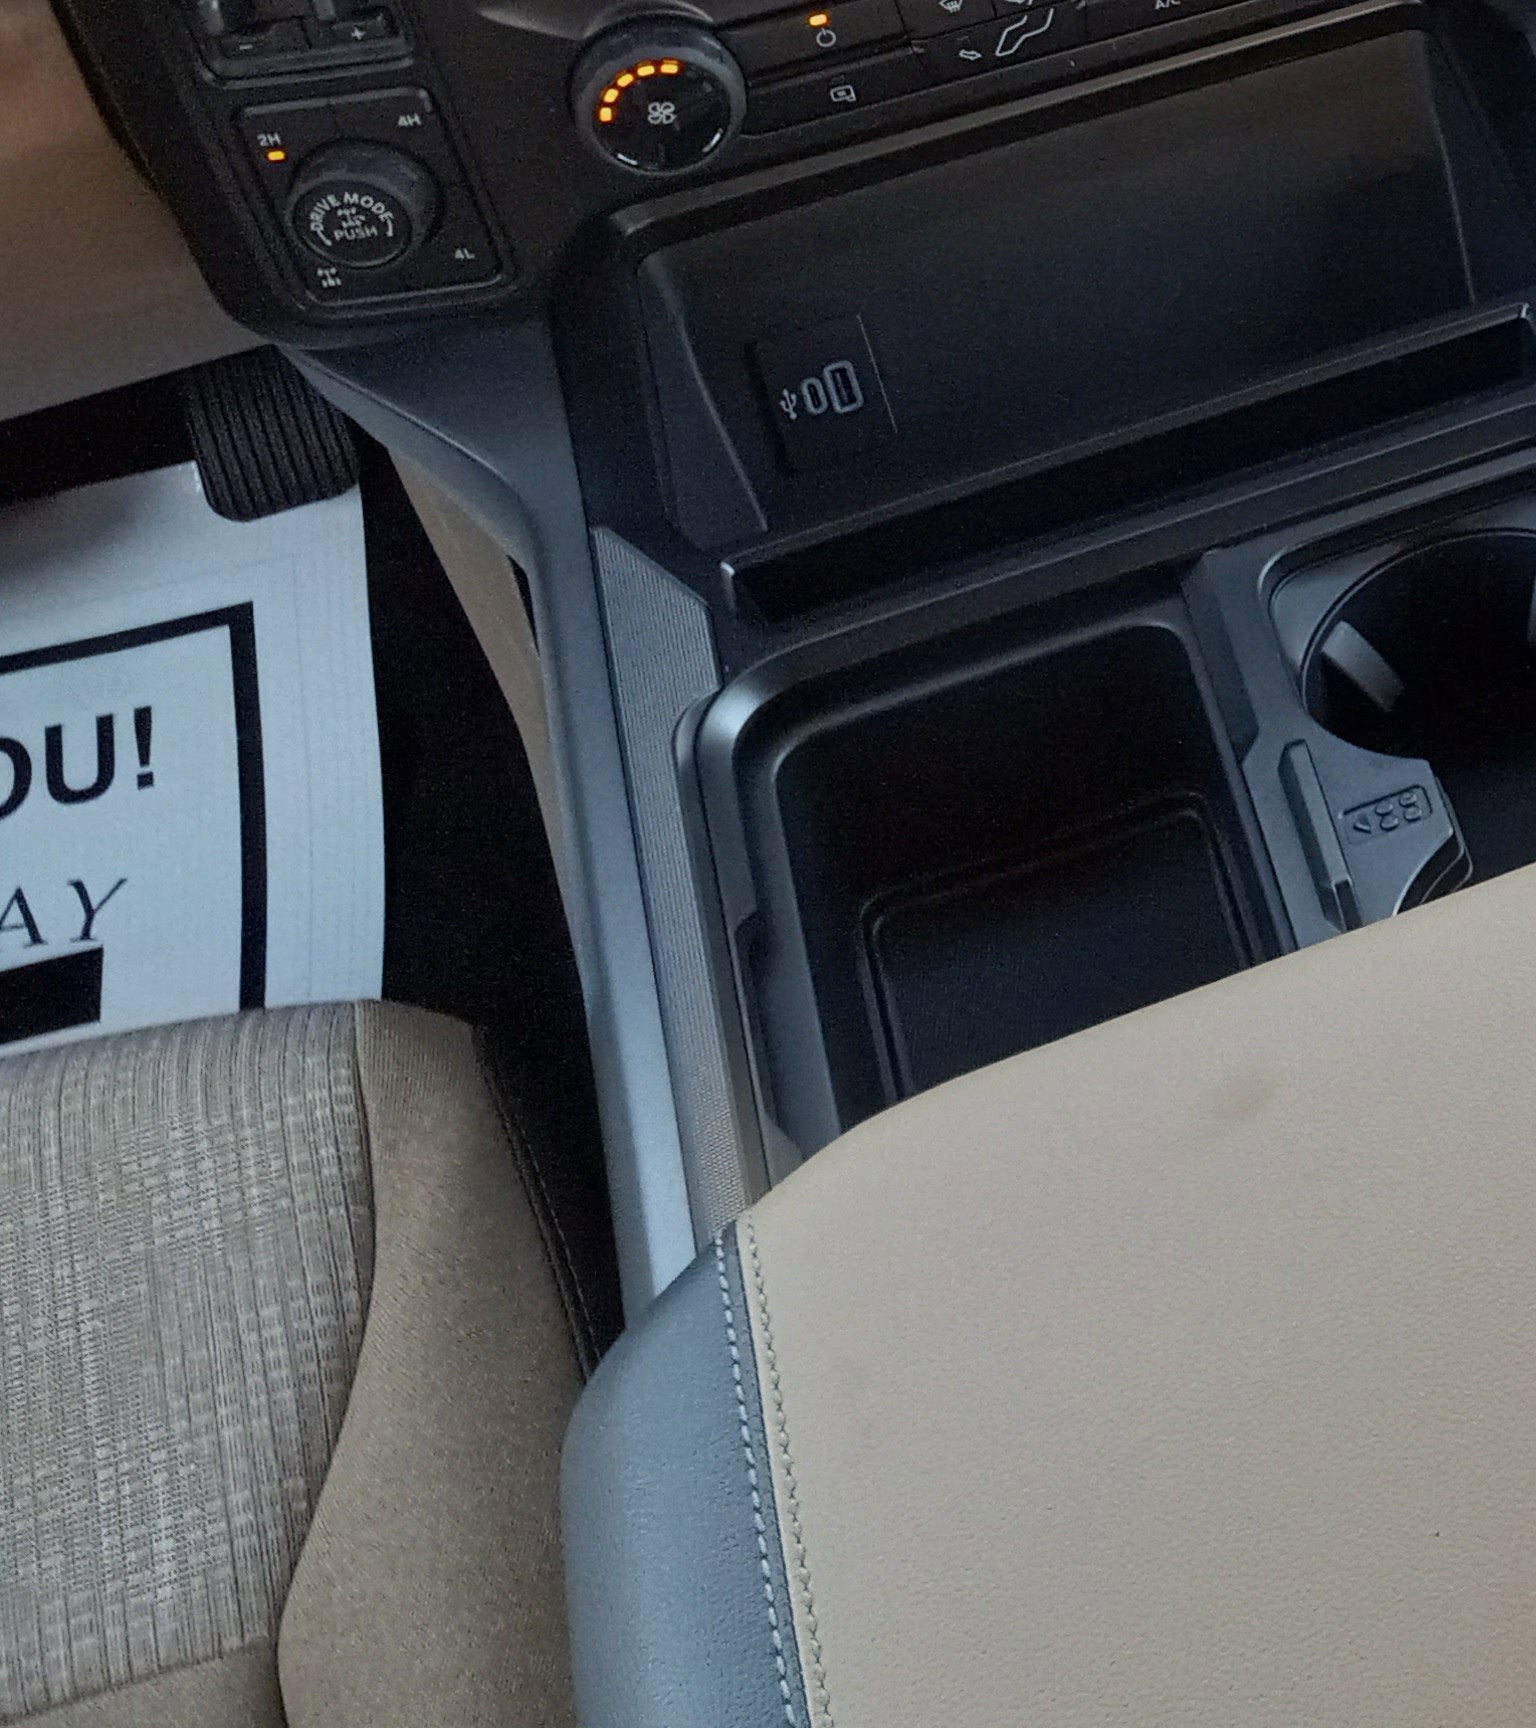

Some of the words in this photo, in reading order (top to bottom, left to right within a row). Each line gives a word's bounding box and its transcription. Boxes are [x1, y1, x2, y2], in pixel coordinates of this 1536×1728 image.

[397, 113, 422, 128] 4H
[257, 132, 281, 147] 2H
[309, 193, 342, 232] DRIVE
[342, 191, 395, 222] MODE
[333, 225, 379, 242] PUSH
[454, 247, 476, 260] 4L
